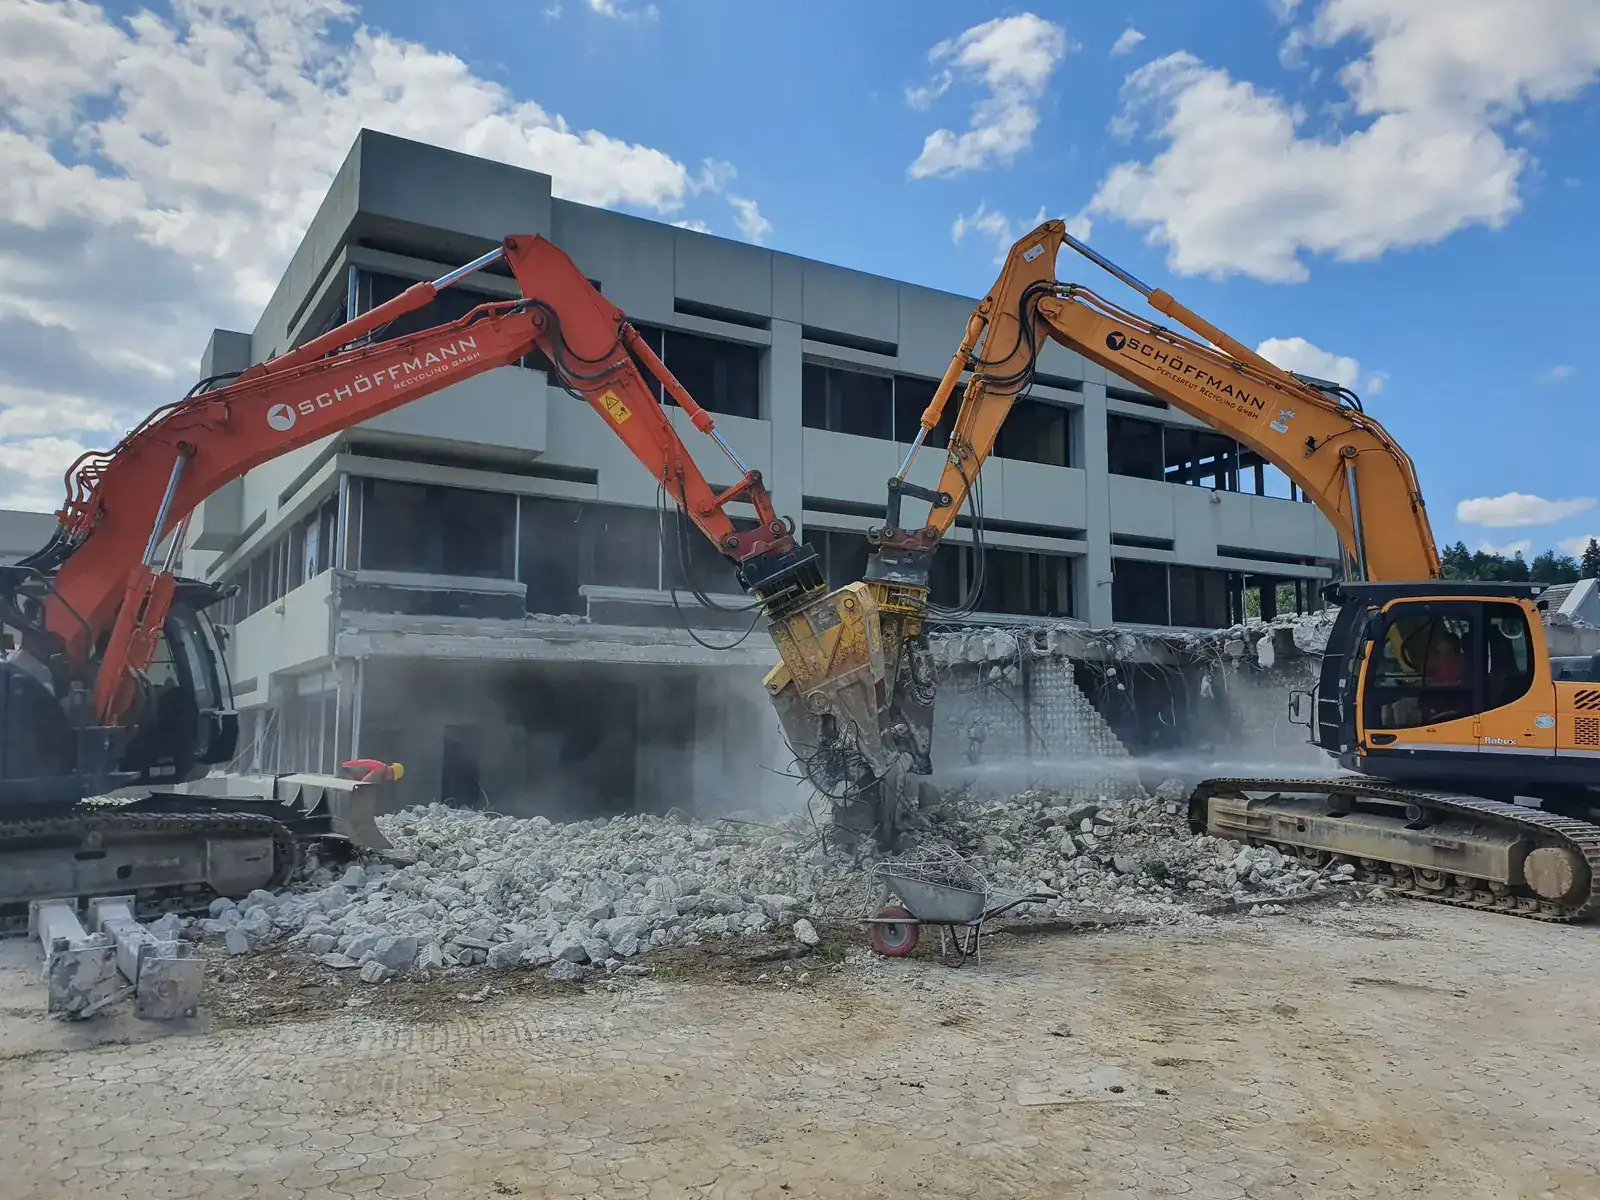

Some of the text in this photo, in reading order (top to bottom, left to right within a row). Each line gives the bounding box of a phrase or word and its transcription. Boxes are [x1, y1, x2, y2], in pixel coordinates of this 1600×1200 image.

[297, 336, 477, 416] SCHÖFFMANN
[393, 363, 449, 390] RECYCLING
[1126, 338, 1266, 411] SCHÖFFMANN
